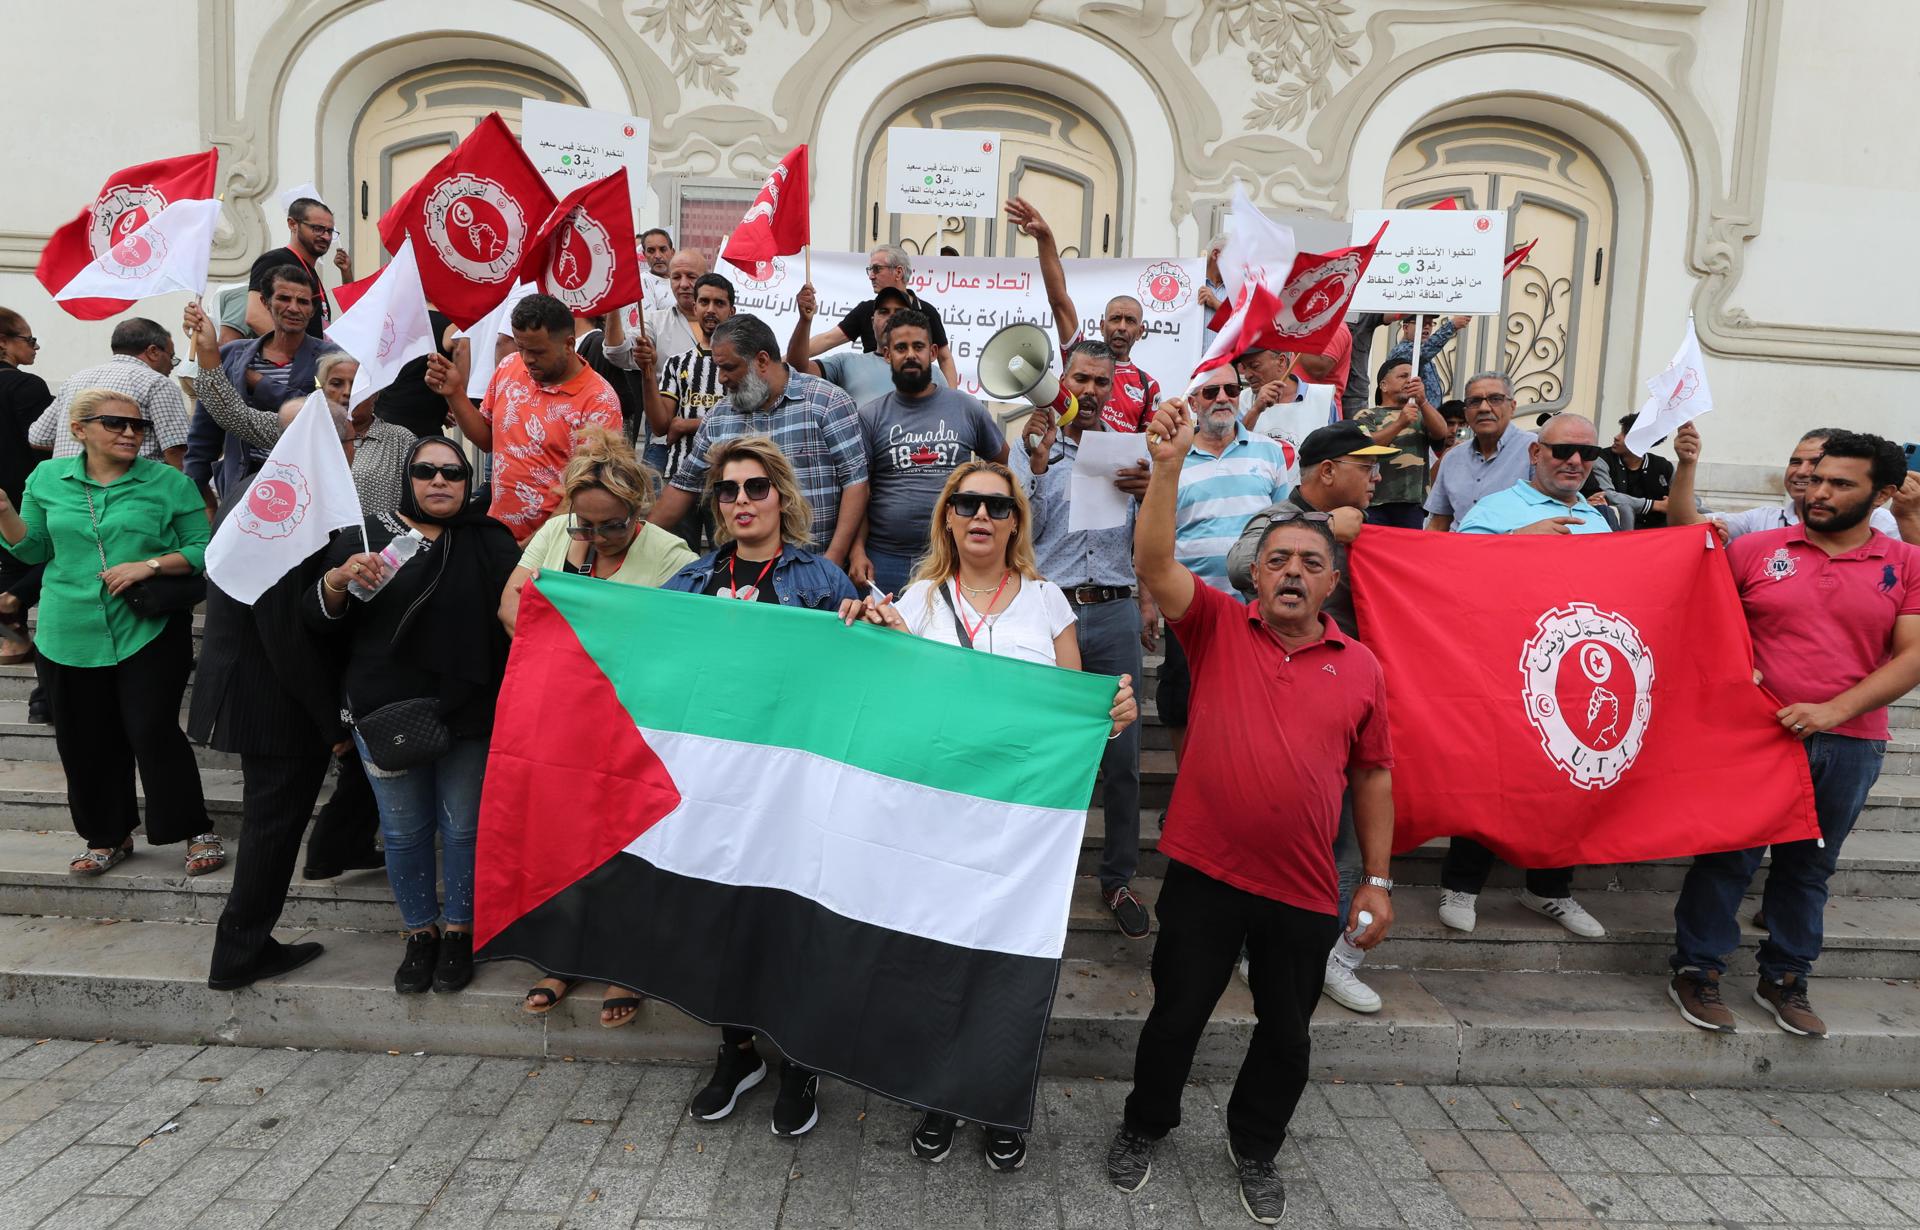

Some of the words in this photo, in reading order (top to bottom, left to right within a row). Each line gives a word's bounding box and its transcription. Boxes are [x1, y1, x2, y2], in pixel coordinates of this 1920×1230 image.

[539, 140, 556, 149] سعيد
[558, 142, 574, 151] قيس
[602, 148, 625, 158] انتخبوا
[574, 154, 581, 166] 3
[582, 157, 594, 167] رقم
[906, 163, 921, 171] سعيد
[923, 163, 937, 172] قيس
[935, 173, 942, 184] 3
[943, 175, 954, 184] رقم
[1373, 248, 1392, 257] سعي
[1395, 246, 1414, 257] قيس
[1448, 248, 1476, 259] انتخبوا
[1416, 259, 1425, 272] 3
[1427, 261, 1441, 272] رقم
[908, 269, 934, 292] تون
[936, 271, 980, 293] عمال
[1367, 275, 1394, 284] للحفاظ
[1426, 276, 1448, 287] تعديل
[1469, 279, 1482, 288] من
[1419, 290, 1443, 299] الطاقة
[958, 342, 971, 358] 6
[889, 419, 958, 446] Canada
